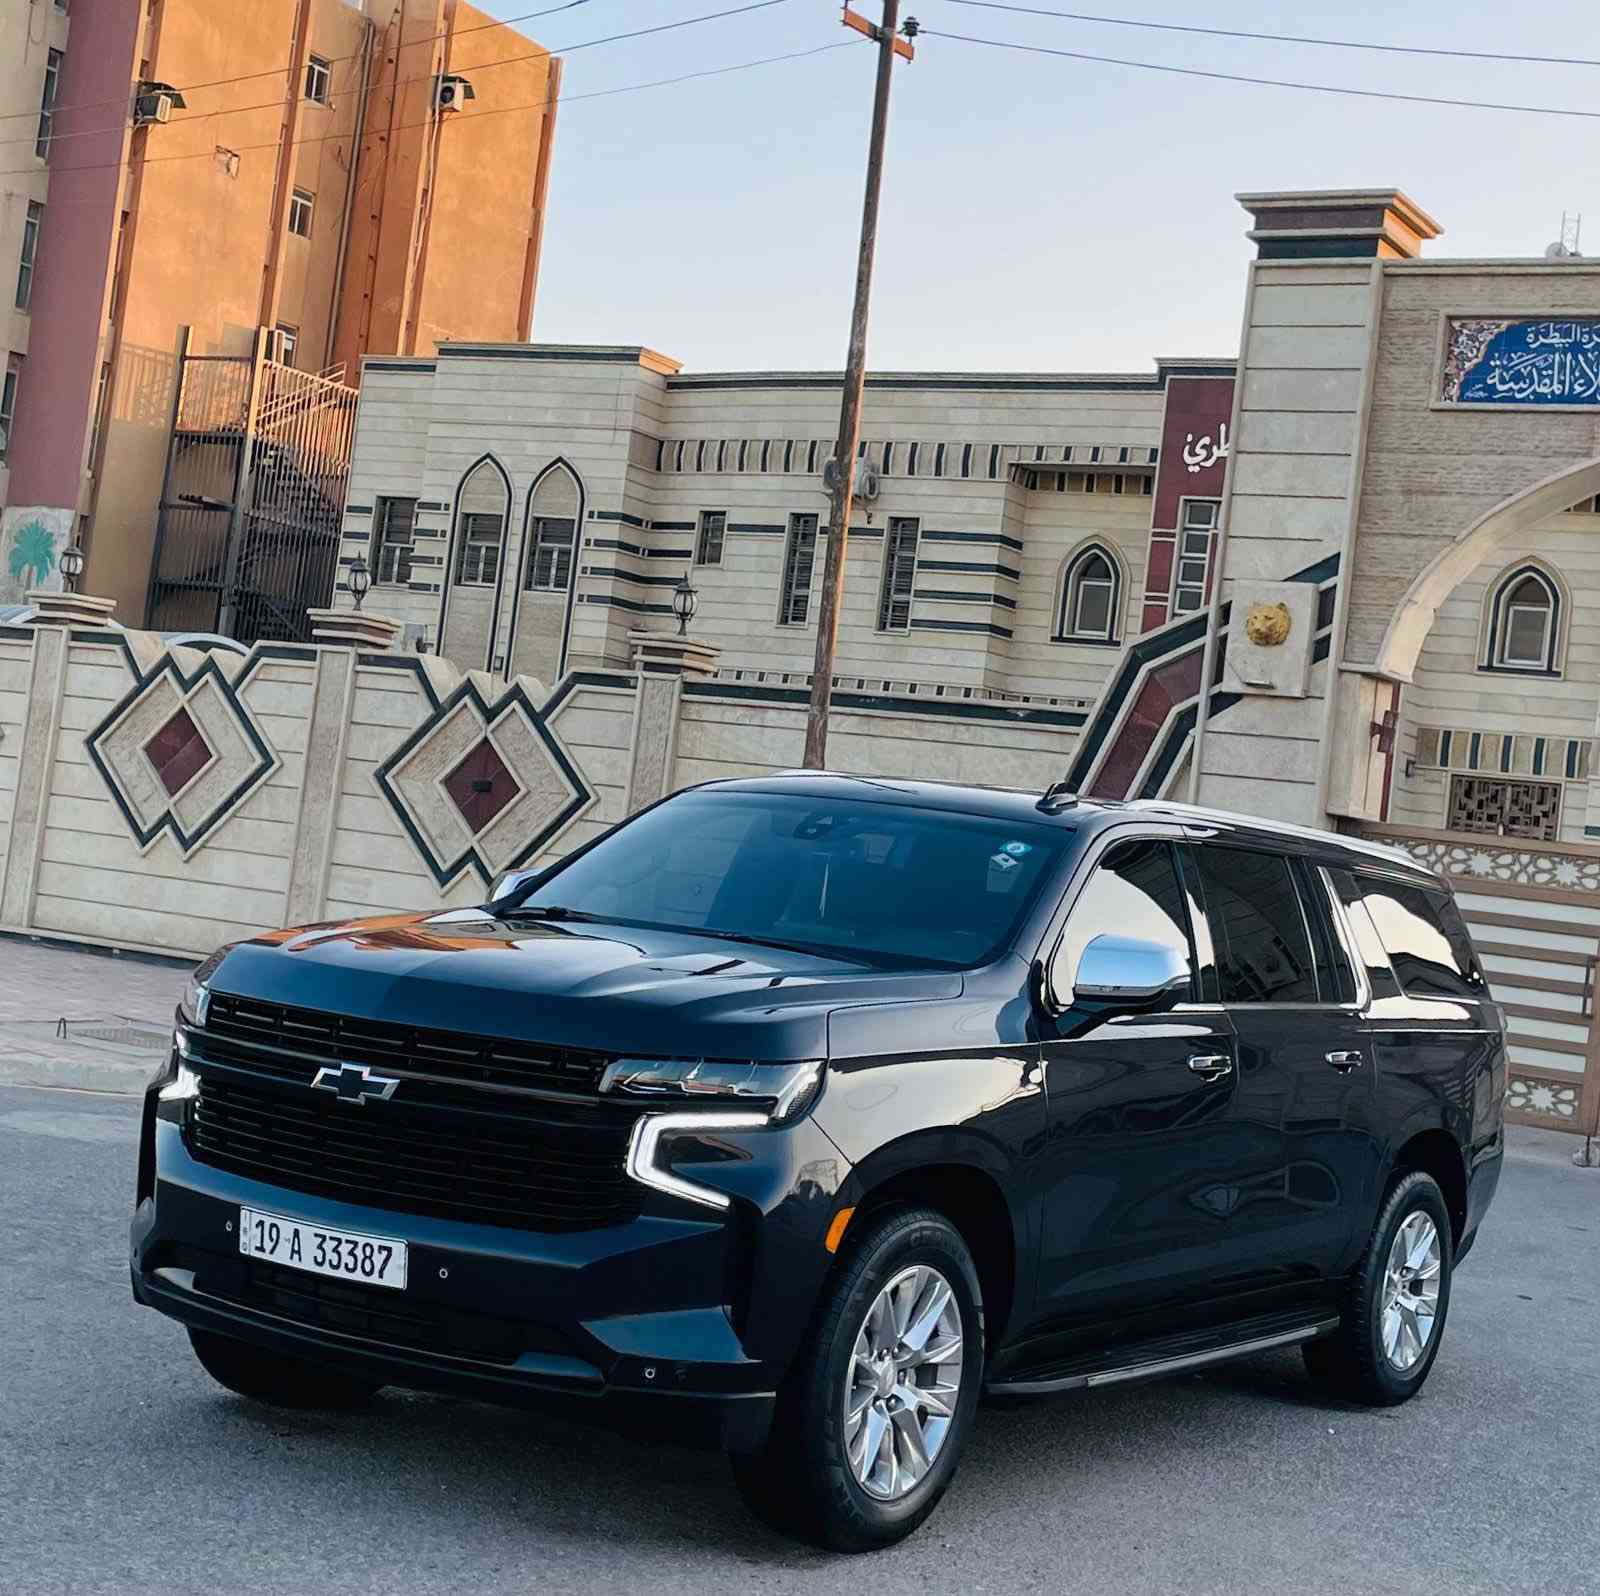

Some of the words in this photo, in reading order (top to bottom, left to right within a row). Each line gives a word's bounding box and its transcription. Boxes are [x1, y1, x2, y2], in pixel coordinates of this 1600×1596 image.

[254, 1219, 281, 1255] 19
[289, 1227, 302, 1263] A
[313, 1232, 393, 1280] 33387
